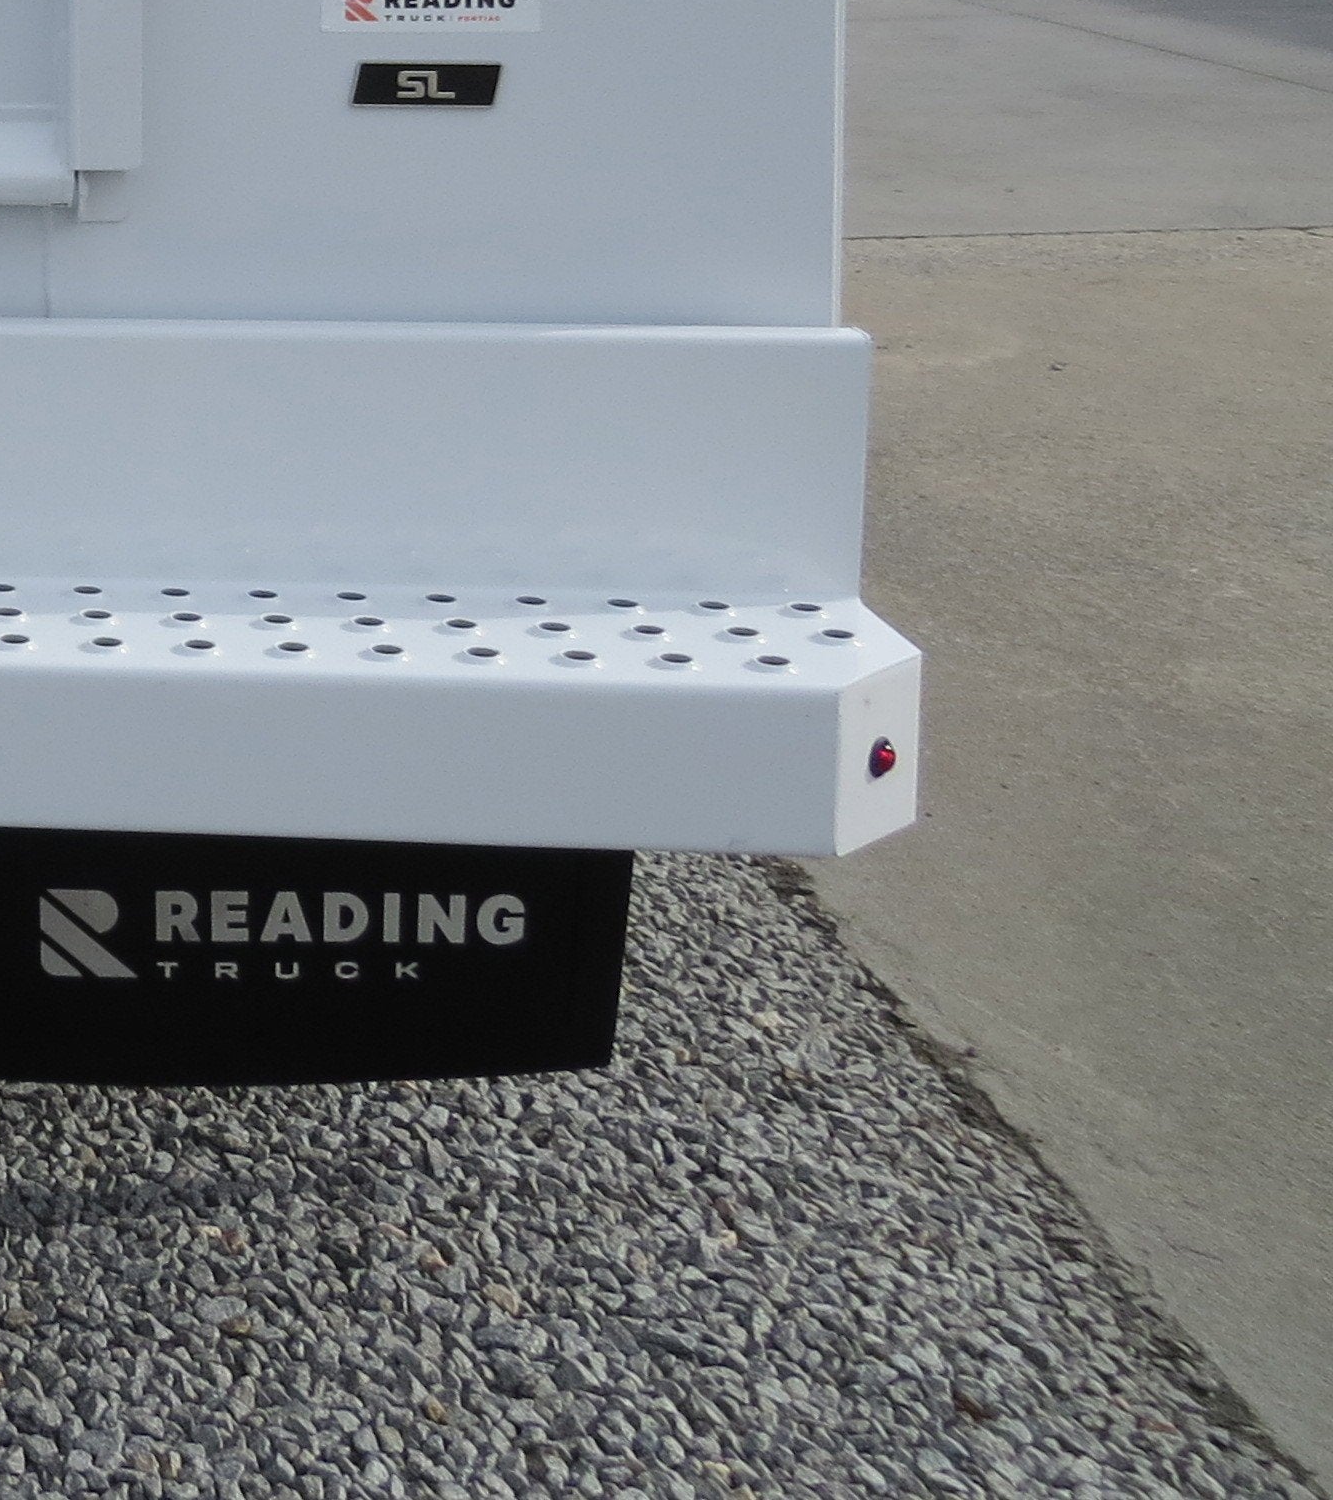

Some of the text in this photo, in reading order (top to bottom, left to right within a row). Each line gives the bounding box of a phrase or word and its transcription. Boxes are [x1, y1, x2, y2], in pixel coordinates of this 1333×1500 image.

[384, 14, 445, 22] TRUCK
[396, 70, 456, 99] SL
[154, 889, 527, 945] READING
[156, 960, 423, 981] TRUCK
